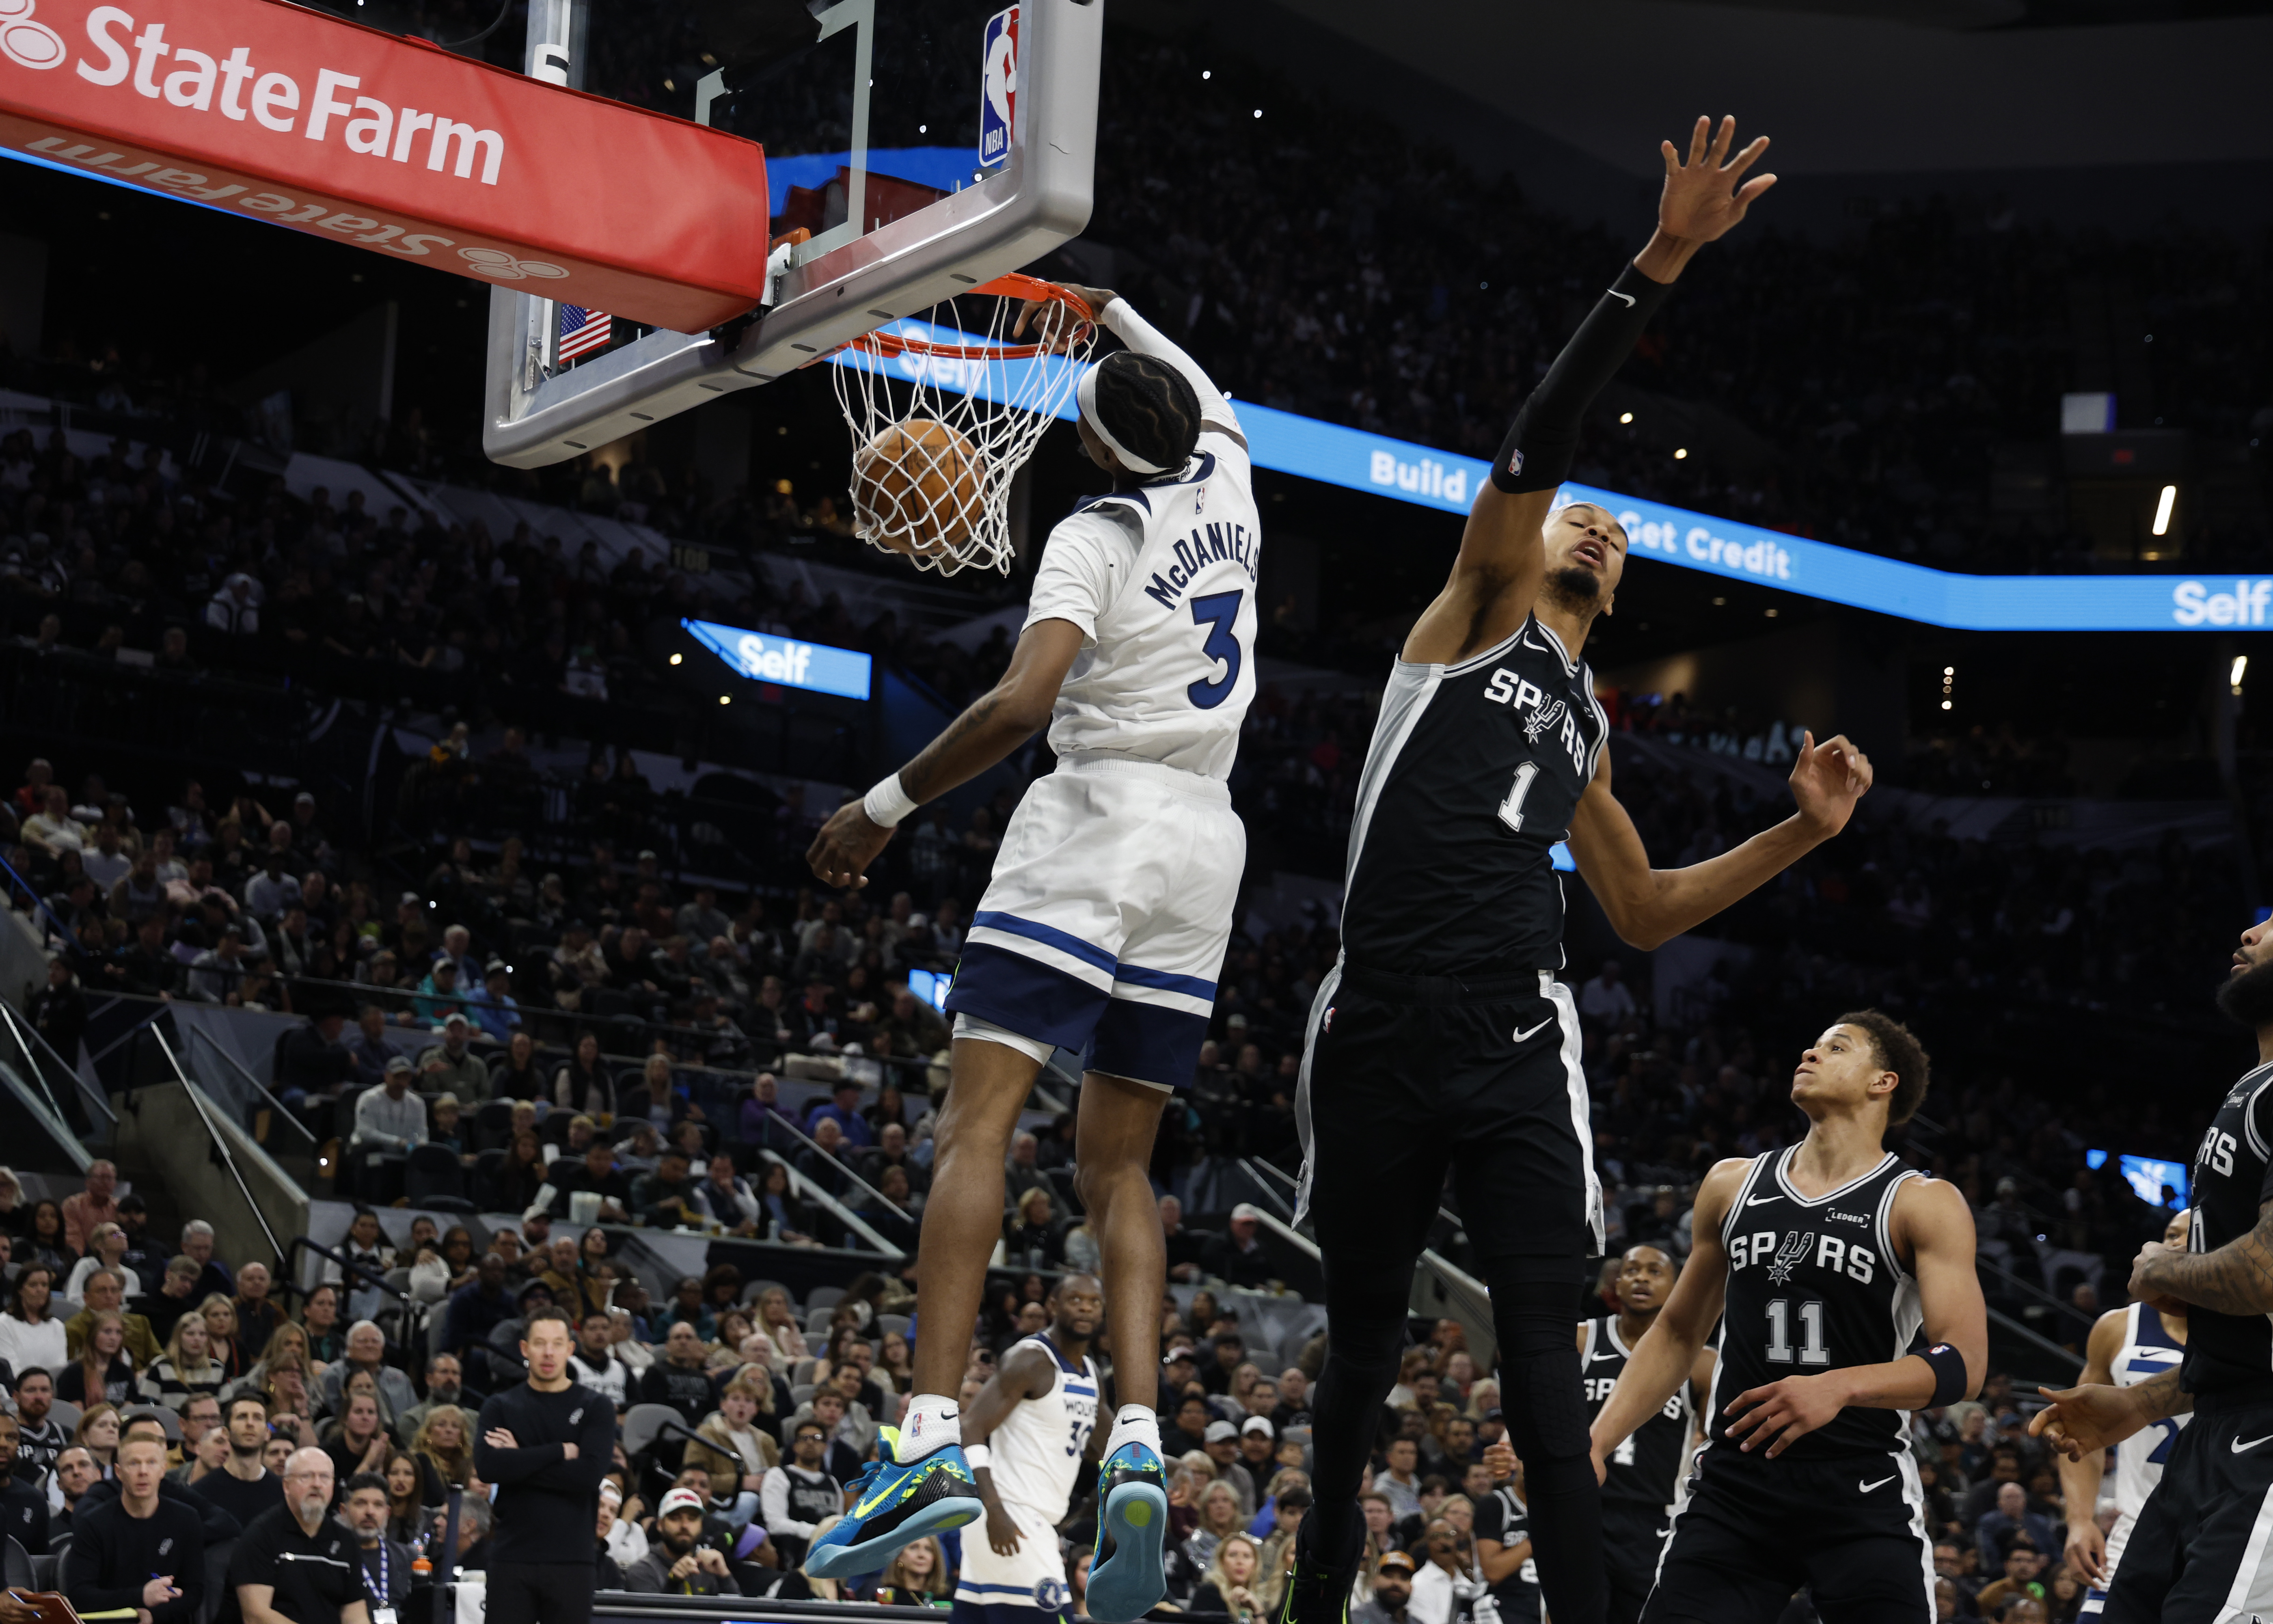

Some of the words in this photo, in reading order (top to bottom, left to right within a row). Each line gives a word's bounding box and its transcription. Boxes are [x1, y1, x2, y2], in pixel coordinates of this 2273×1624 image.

[985, 127, 1003, 156] NBA
[1370, 450, 1468, 504] Build
[1144, 522, 1258, 611] McDANIELS
[1617, 510, 1678, 553] Get
[1685, 527, 1791, 581] Credit
[2172, 579, 2273, 626] Self
[738, 634, 812, 685] Self
[1187, 589, 1243, 710] 3
[1498, 760, 1540, 833] 1
[1831, 1211, 1865, 1224] LEDGER
[1729, 1230, 1876, 1287] SPURS
[1764, 1298, 1830, 1365] 11
